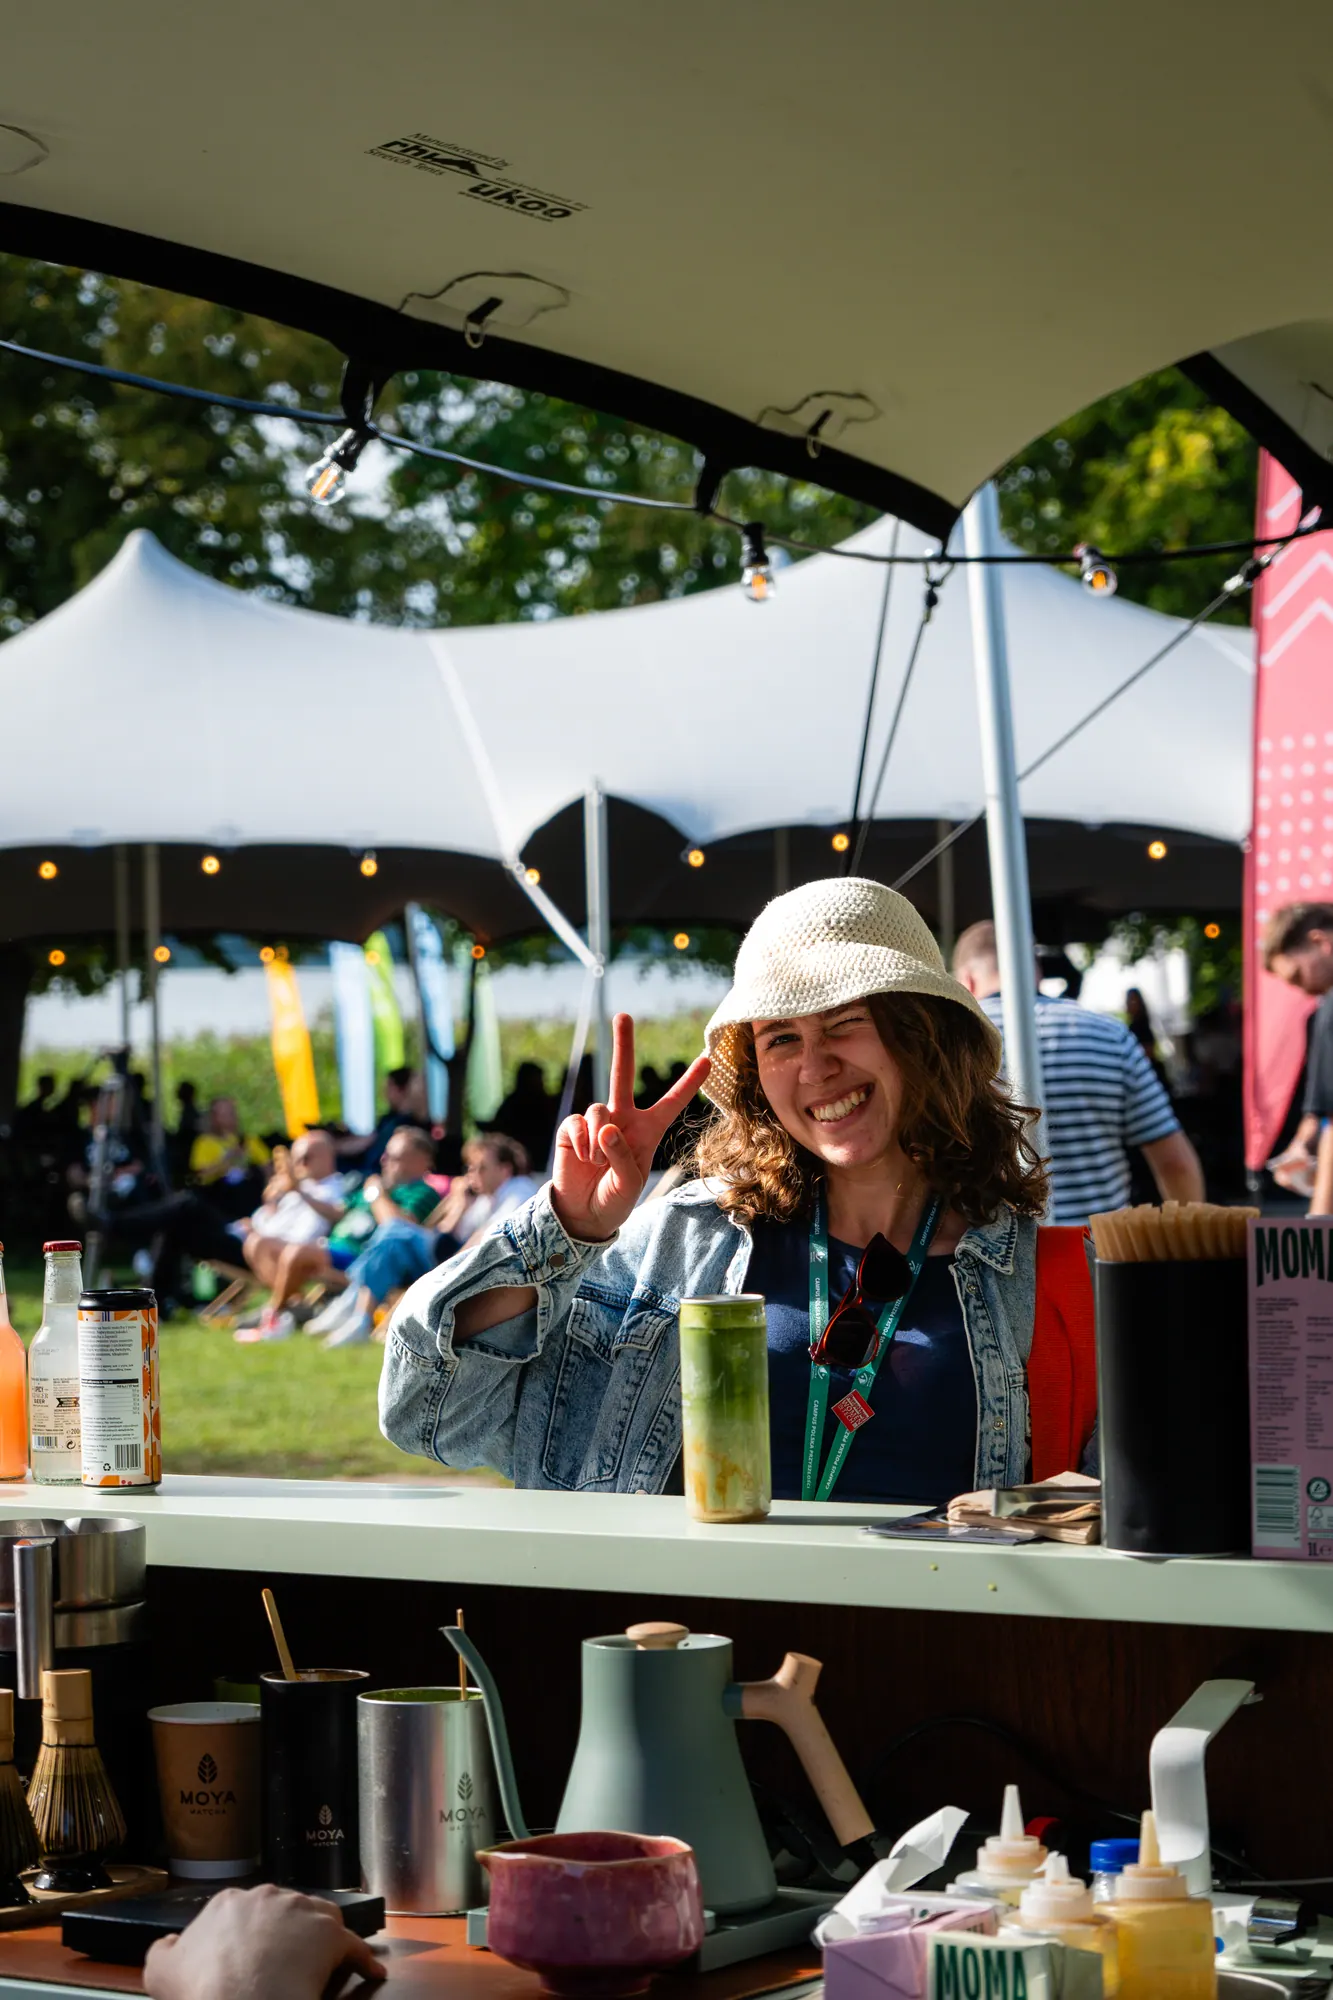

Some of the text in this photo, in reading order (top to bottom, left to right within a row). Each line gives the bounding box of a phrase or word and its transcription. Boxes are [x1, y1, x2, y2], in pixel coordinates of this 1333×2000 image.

[364, 148, 446, 177] Stretch Tents
[408, 132, 513, 169] Manufactured by
[467, 183, 572, 219] ukoo
[919, 1226, 930, 1246] CAMPUS
[881, 1317, 894, 1336] POLSKA
[811, 1400, 820, 1425] CAMPUS
[809, 1425, 817, 1449] POLSKA
[825, 1466, 837, 1490] CAMPUS
[834, 1443, 846, 1466] POLSKA
[180, 1789, 237, 1806] MOYA
[439, 1805, 487, 1823] MOYA
[306, 1828, 345, 1841] MOYA
[935, 1944, 1028, 2000] MOMA
